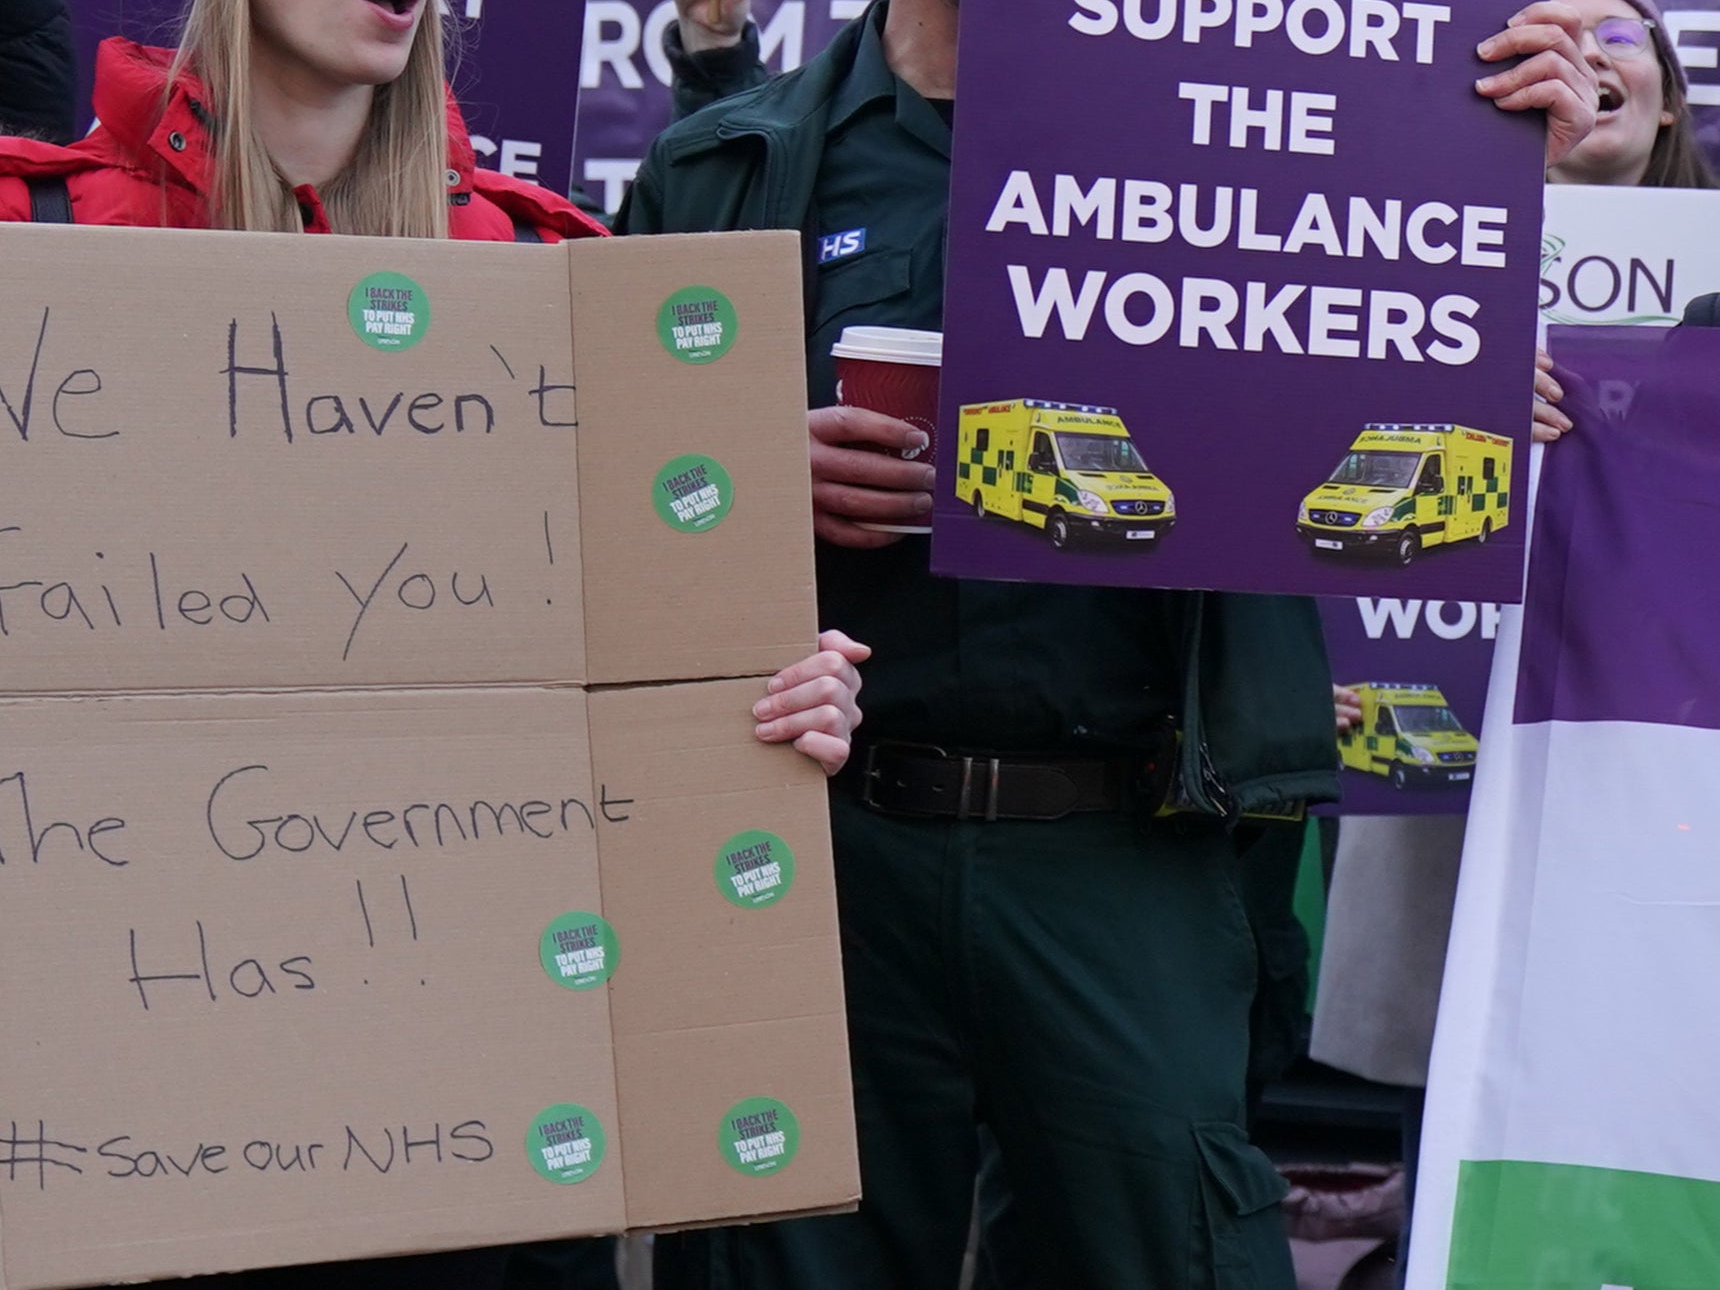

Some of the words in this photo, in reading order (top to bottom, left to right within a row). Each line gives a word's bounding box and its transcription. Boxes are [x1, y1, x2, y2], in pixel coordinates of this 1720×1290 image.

[1178, 81, 1336, 155] THE
[986, 171, 1509, 268] AMBULANCE
[821, 231, 863, 262] HS
[370, 287, 394, 299] BACK
[396, 289, 413, 301] THE
[1539, 255, 1675, 314] SON
[370, 300, 408, 312] STRIKES
[676, 302, 700, 315] BACK
[701, 300, 718, 312] THE
[1006, 263, 1481, 366] WORKERS
[363, 309, 376, 321] TO
[376, 310, 394, 323] PUT
[395, 311, 415, 324] NHS
[678, 313, 714, 326] STRIKES
[366, 321, 383, 333] PAY
[384, 322, 411, 335] RIGHT
[672, 326, 684, 338] TO
[685, 324, 702, 337] PUT
[702, 322, 722, 335] NHS
[676, 337, 693, 350] PAY
[694, 334, 720, 347] RIGHT
[1057, 415, 1121, 429] AMBULANCE
[208, 766, 634, 860] Government
[730, 849, 754, 863] BACK
[753, 841, 772, 855] THE
[734, 853, 771, 875] STRIKES
[730, 873, 743, 887] TO
[742, 868, 760, 883] PUT
[760, 862, 782, 877] NHS
[736, 882, 755, 898] PAY
[753, 873, 782, 892] RIGHT
[556, 930, 582, 943] BACK
[582, 925, 598, 937] THE
[555, 953, 568, 967] TO
[567, 949, 586, 964] PUT
[586, 945, 605, 961] NHS
[560, 938, 596, 954] STRIKES
[129, 921, 315, 1009] Has
[560, 963, 578, 977] PAY
[576, 957, 604, 973] RIGHT
[543, 1121, 568, 1135] BACK
[568, 1116, 584, 1129] THE
[736, 1115, 762, 1129] BACK
[761, 1109, 778, 1123] THE
[546, 1129, 582, 1147] STRIKES
[739, 1121, 776, 1141] STRIKES
[541, 1147, 554, 1161] TO
[554, 1141, 572, 1158] PUT
[572, 1137, 592, 1153] NHS
[734, 1139, 748, 1153] TO
[746, 1135, 764, 1151] PUT
[764, 1130, 785, 1145] NHS
[546, 1155, 564, 1171] PAY
[563, 1150, 590, 1167] RIGHT
[739, 1149, 758, 1164] PAY
[756, 1141, 784, 1159] RIGHT
